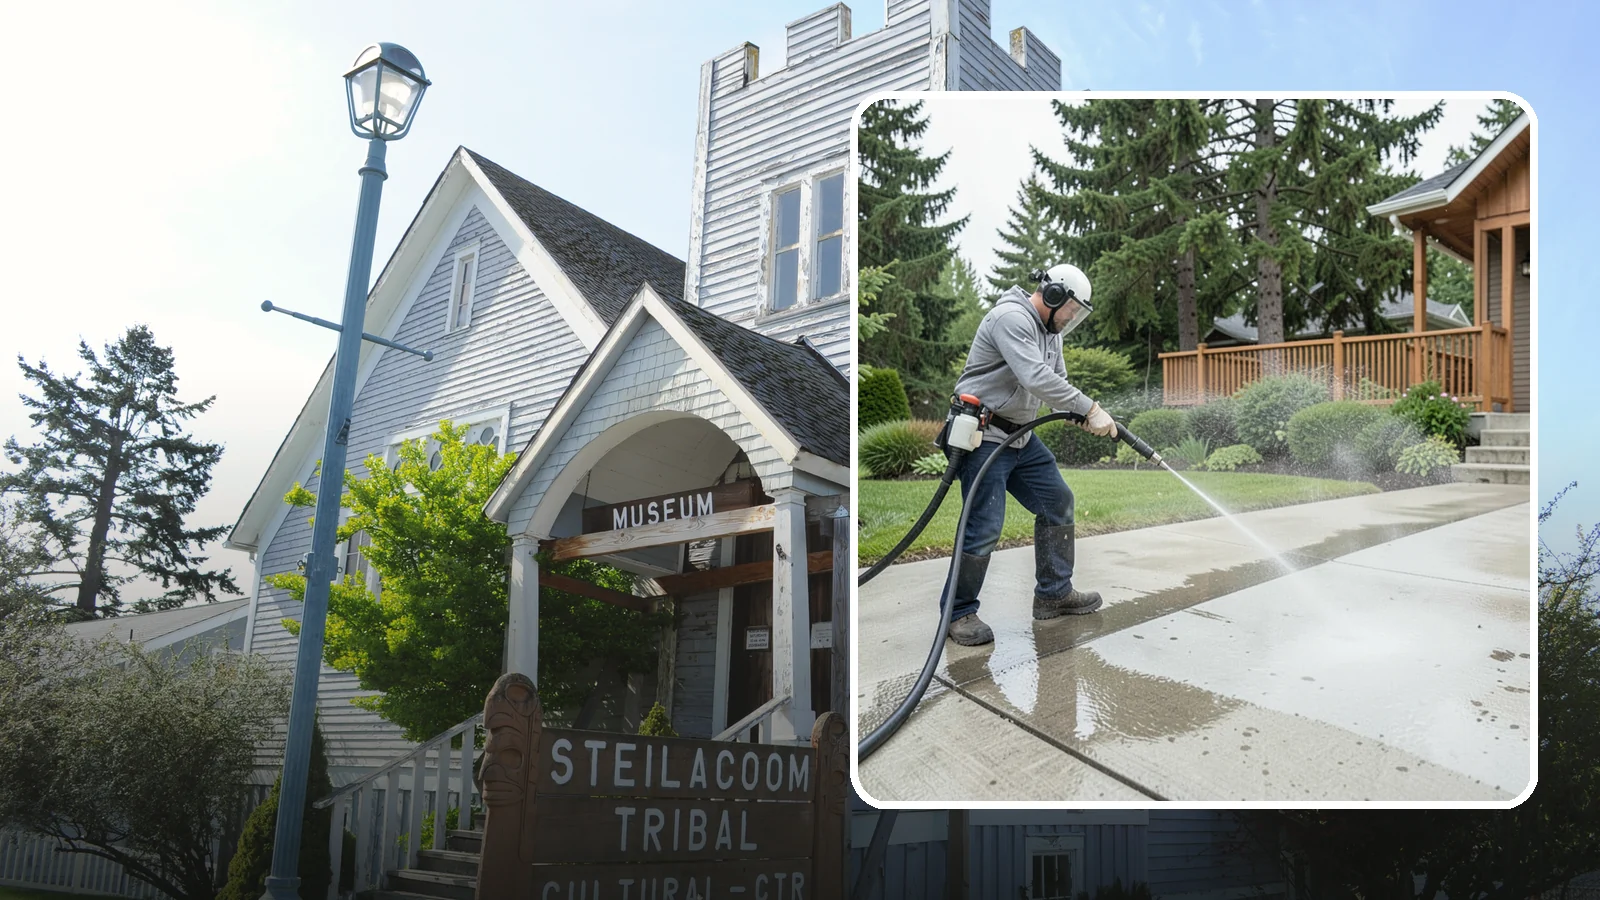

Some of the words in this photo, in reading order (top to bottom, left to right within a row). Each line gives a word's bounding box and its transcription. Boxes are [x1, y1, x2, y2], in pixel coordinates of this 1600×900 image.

[613, 491, 713, 531] MUSEUM
[550, 738, 810, 793] STEILACOOM
[614, 806, 758, 852] TRIBAL
